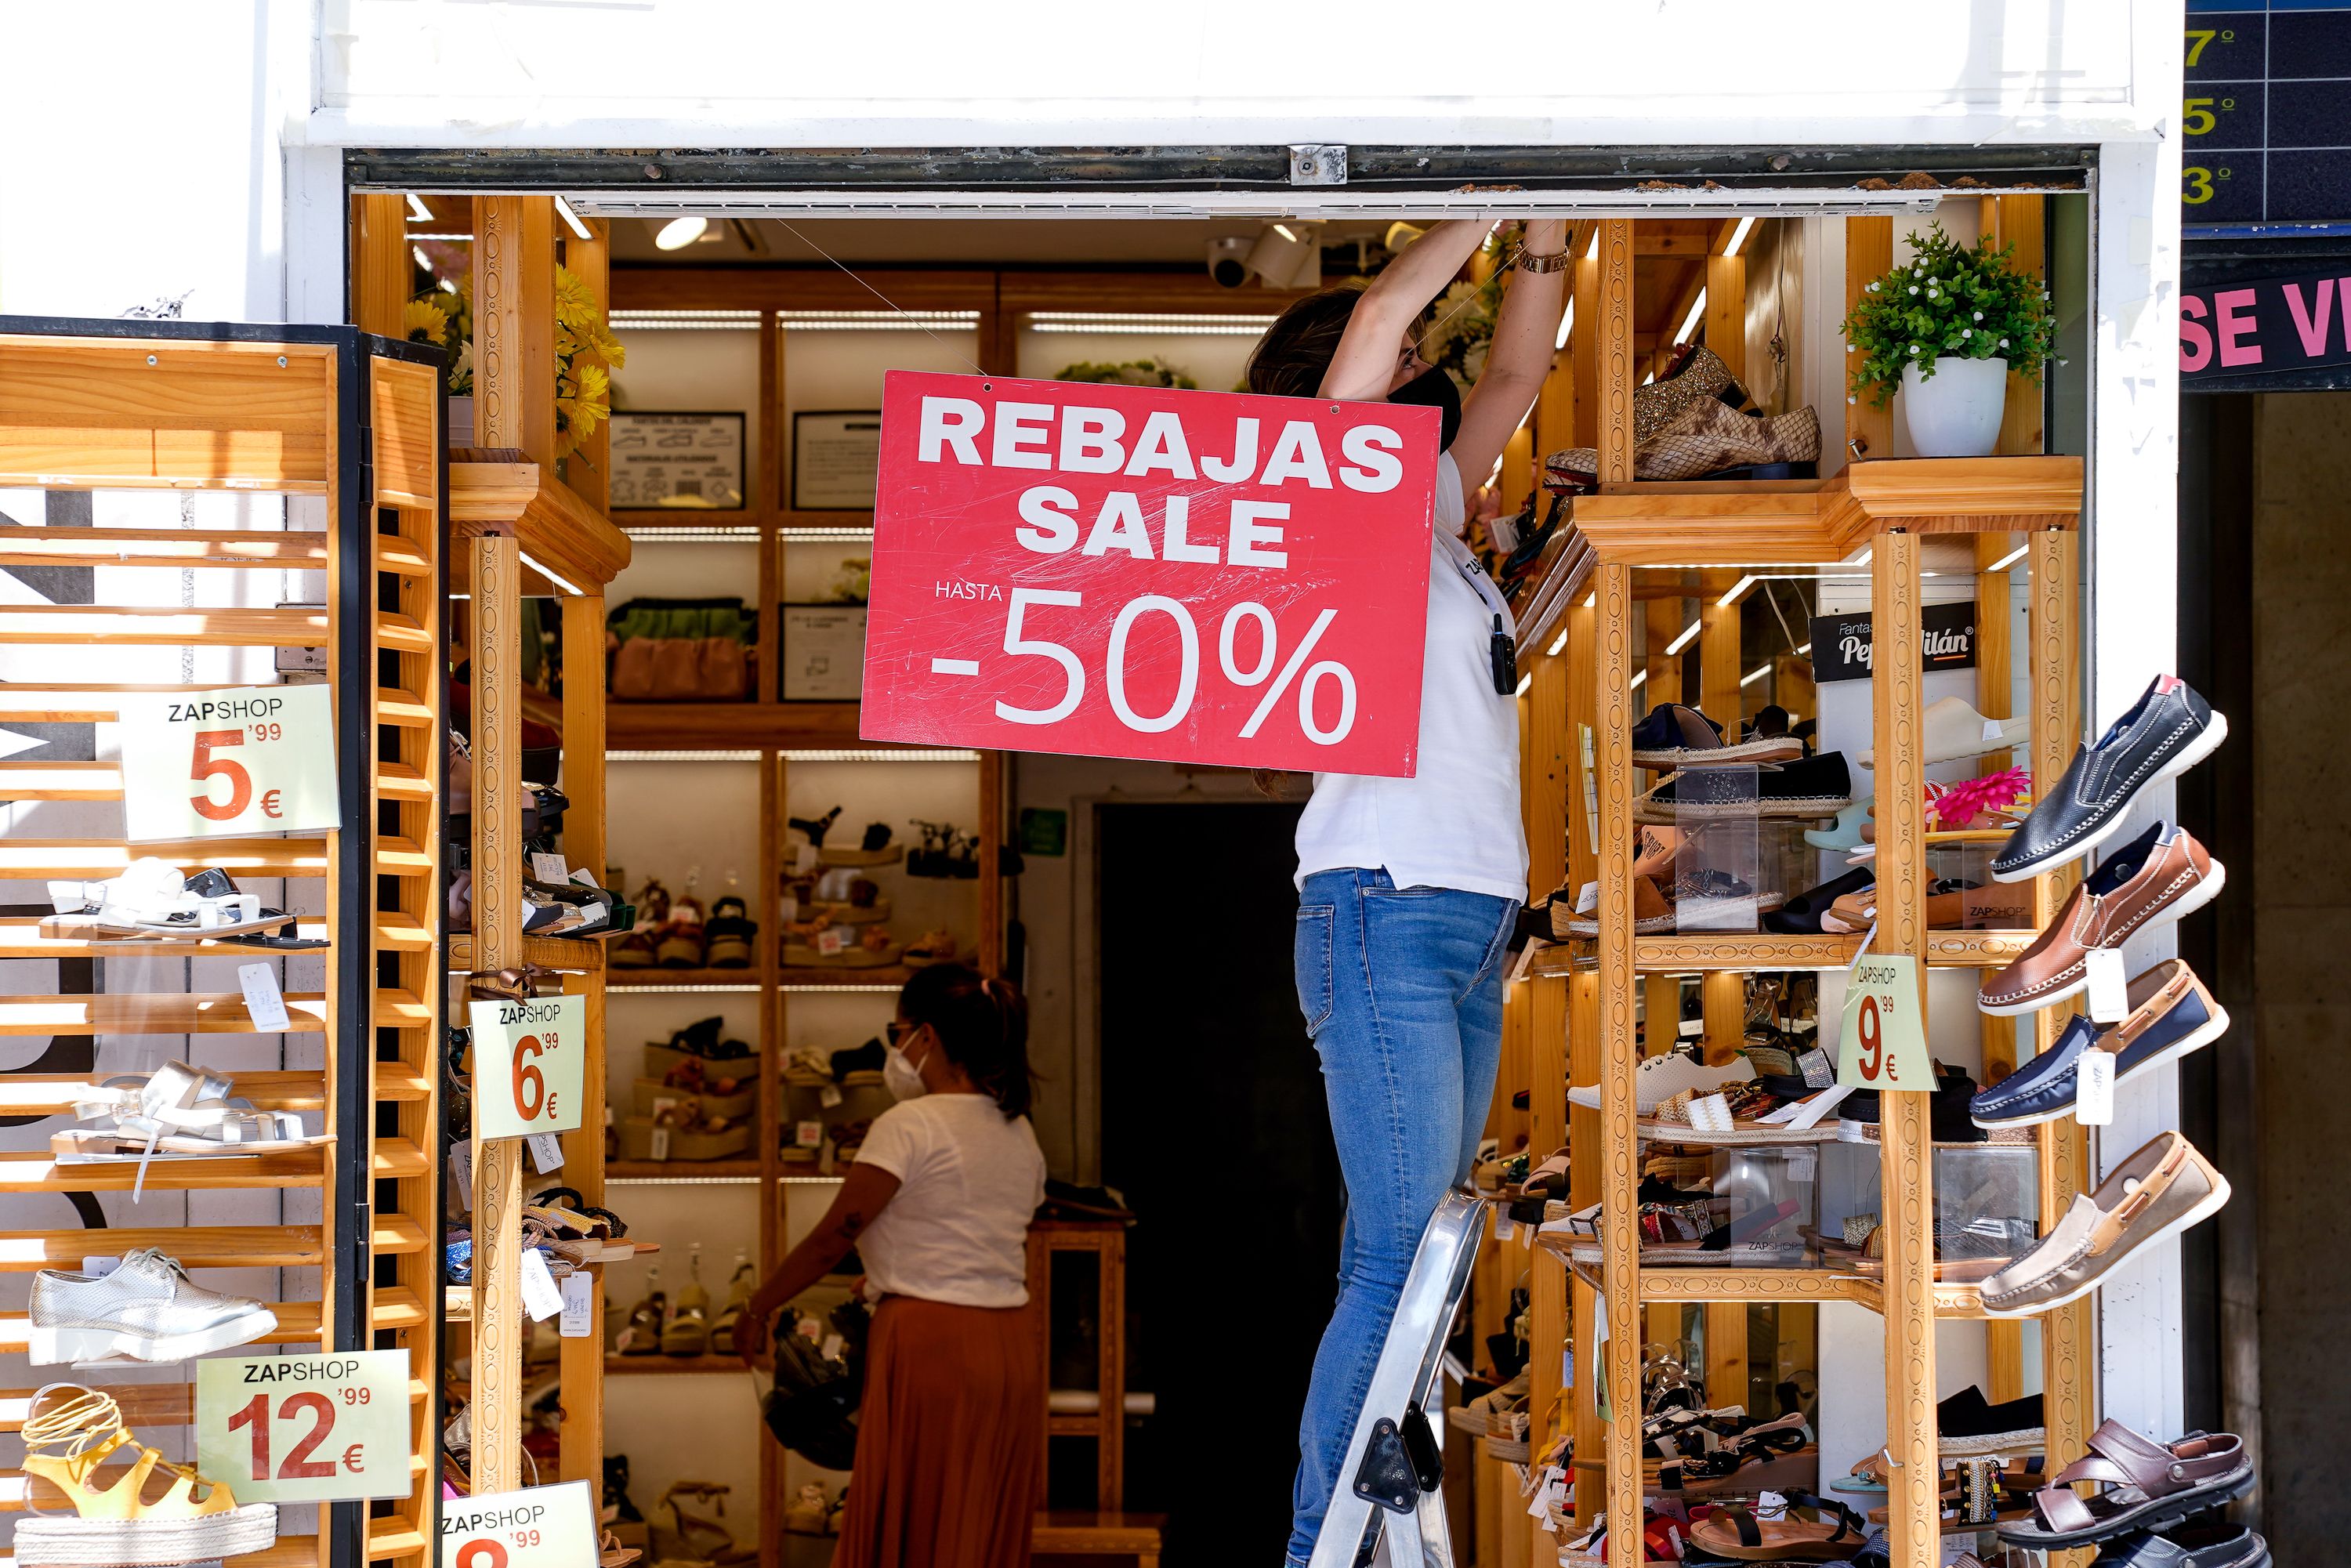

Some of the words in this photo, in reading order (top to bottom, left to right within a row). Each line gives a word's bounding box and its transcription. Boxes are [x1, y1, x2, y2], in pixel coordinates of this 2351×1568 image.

[2180, 288, 2263, 373] SE
[918, 395, 1404, 494] REBAJAS
[1016, 485, 1291, 570] SALE
[935, 580, 1002, 601] HASTA
[1838, 622, 1874, 636] Fantas
[1838, 636, 1874, 670] Pep
[930, 587, 1357, 746] -50%
[168, 698, 283, 722] ZAPSHOP
[1969, 905, 2027, 918] ZAPSHOP
[1858, 966, 1896, 984] ZAPSHOP
[499, 1004, 561, 1025] ZAPSHOP
[540, 1134, 554, 1164] PSHOP
[1748, 1241, 1798, 1251] ZAPSHOP
[244, 1360, 360, 1383] ZAPSHOP
[442, 1505, 545, 1535] ZAPSHOP
